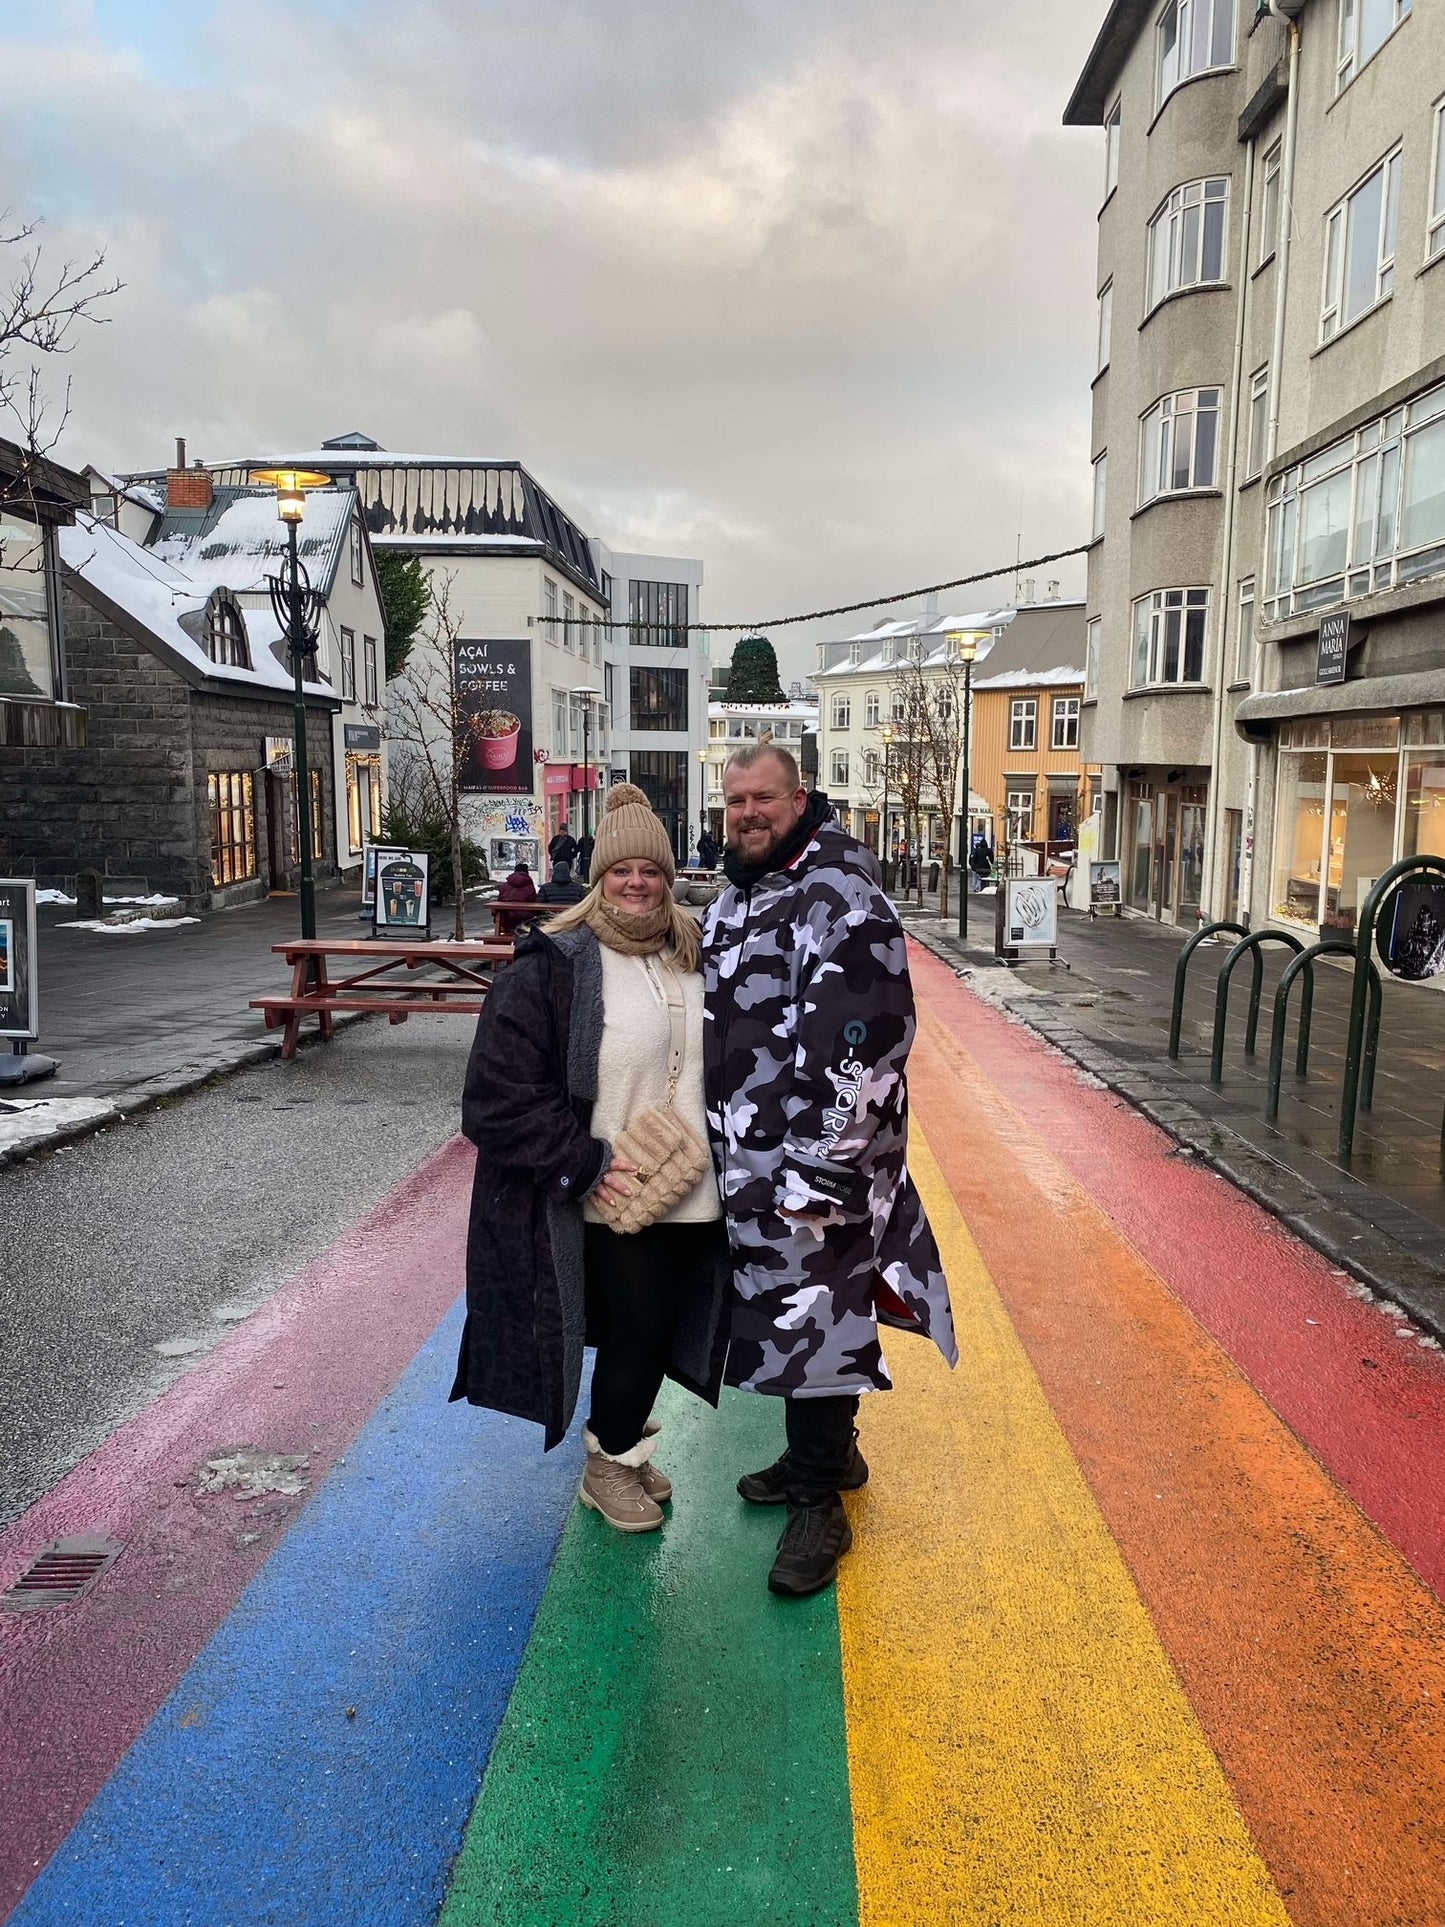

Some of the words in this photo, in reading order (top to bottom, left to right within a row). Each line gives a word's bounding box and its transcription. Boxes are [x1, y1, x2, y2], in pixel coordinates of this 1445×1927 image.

[1322, 619, 1344, 638] ANNA
[458, 644, 488, 660] AÇAÍ
[459, 663, 504, 675] BOWLS
[507, 663, 516, 675] &
[459, 680, 508, 691] COFFEE
[814, 1175, 837, 1189] STORM
